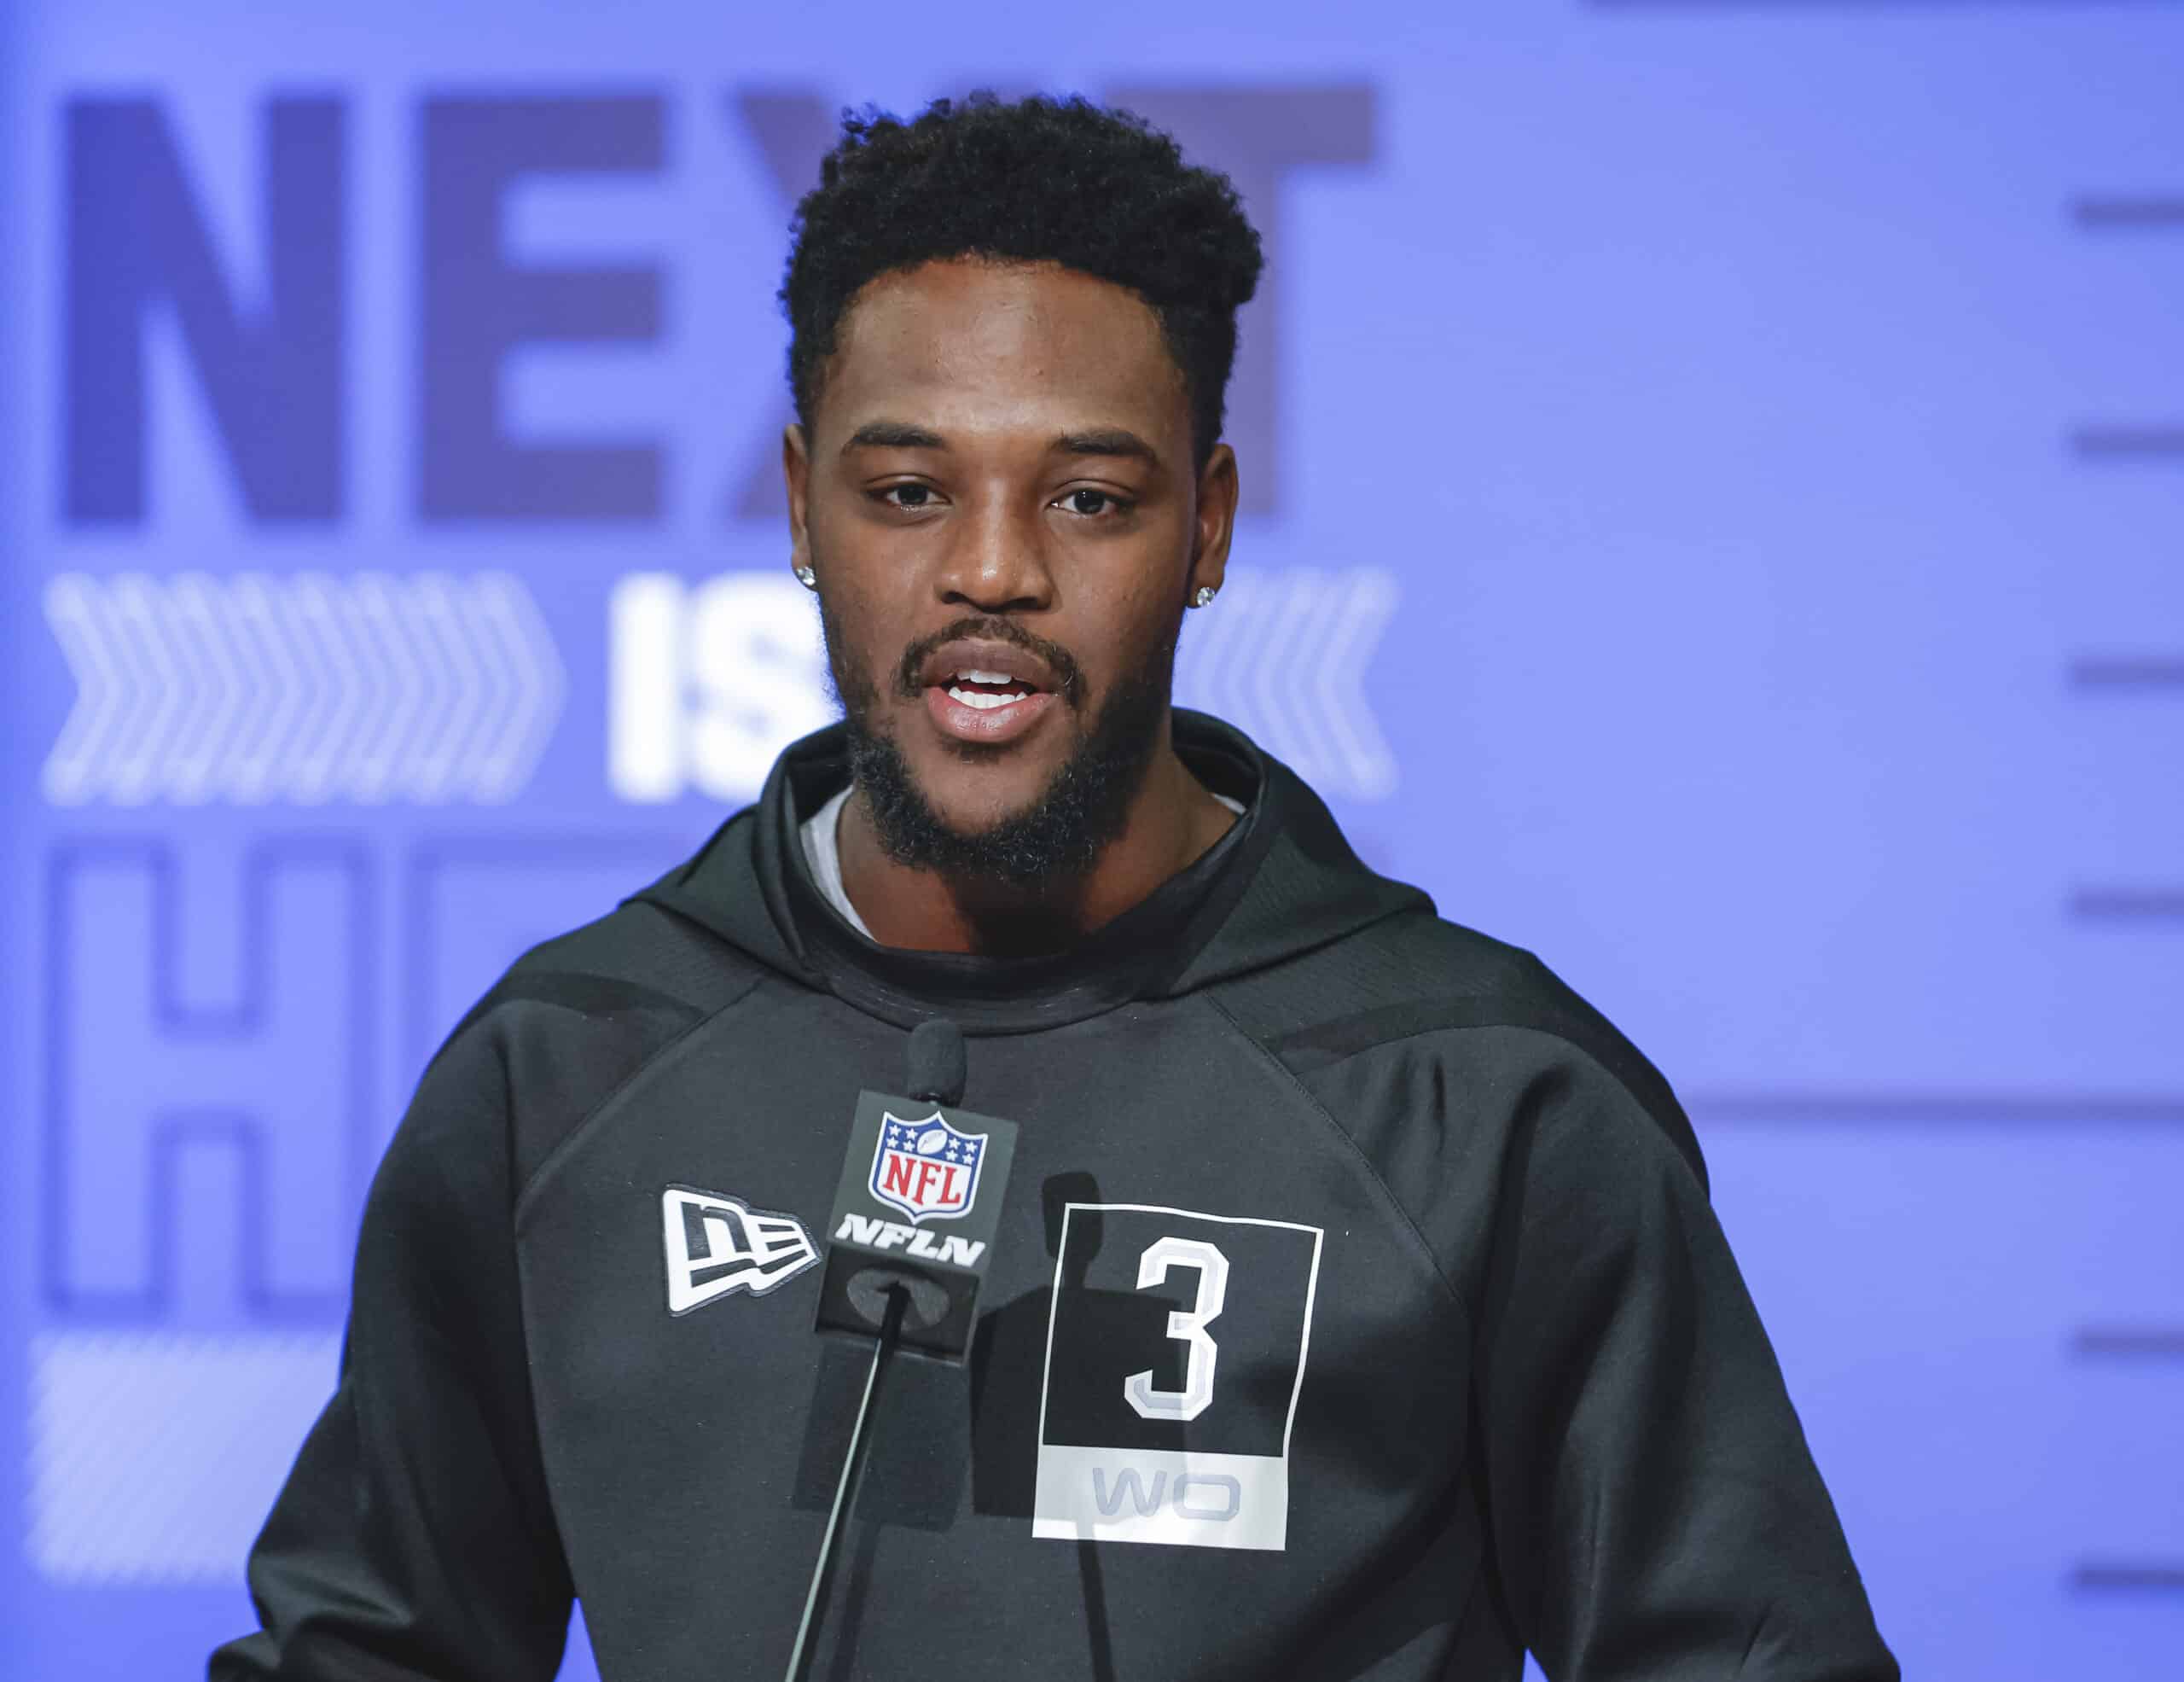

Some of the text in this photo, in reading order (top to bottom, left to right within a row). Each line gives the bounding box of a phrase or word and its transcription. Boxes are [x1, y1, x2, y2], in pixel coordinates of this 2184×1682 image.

[882, 1153, 961, 1206] NFL
[834, 1213, 986, 1268] NFLN
[1124, 1236, 1229, 1422] 3
[1092, 1467, 1241, 1522] WO
